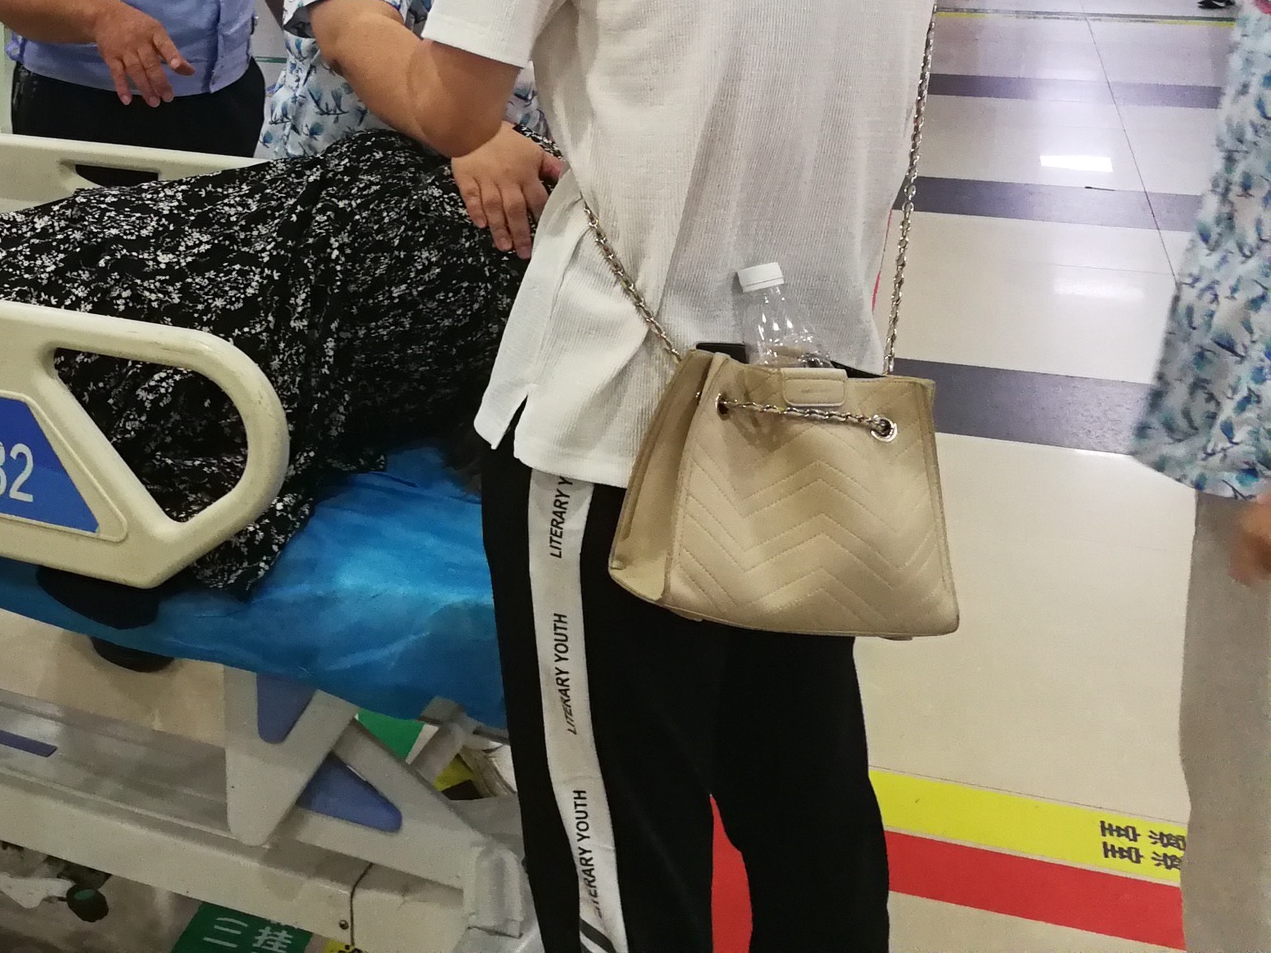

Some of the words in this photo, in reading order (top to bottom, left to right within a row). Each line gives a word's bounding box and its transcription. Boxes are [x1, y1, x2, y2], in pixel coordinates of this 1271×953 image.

[549, 489, 571, 559] LITERARY
[553, 612, 569, 665] YOUTH
[557, 667, 578, 736] LITERARY
[573, 789, 588, 844] YOUTH
